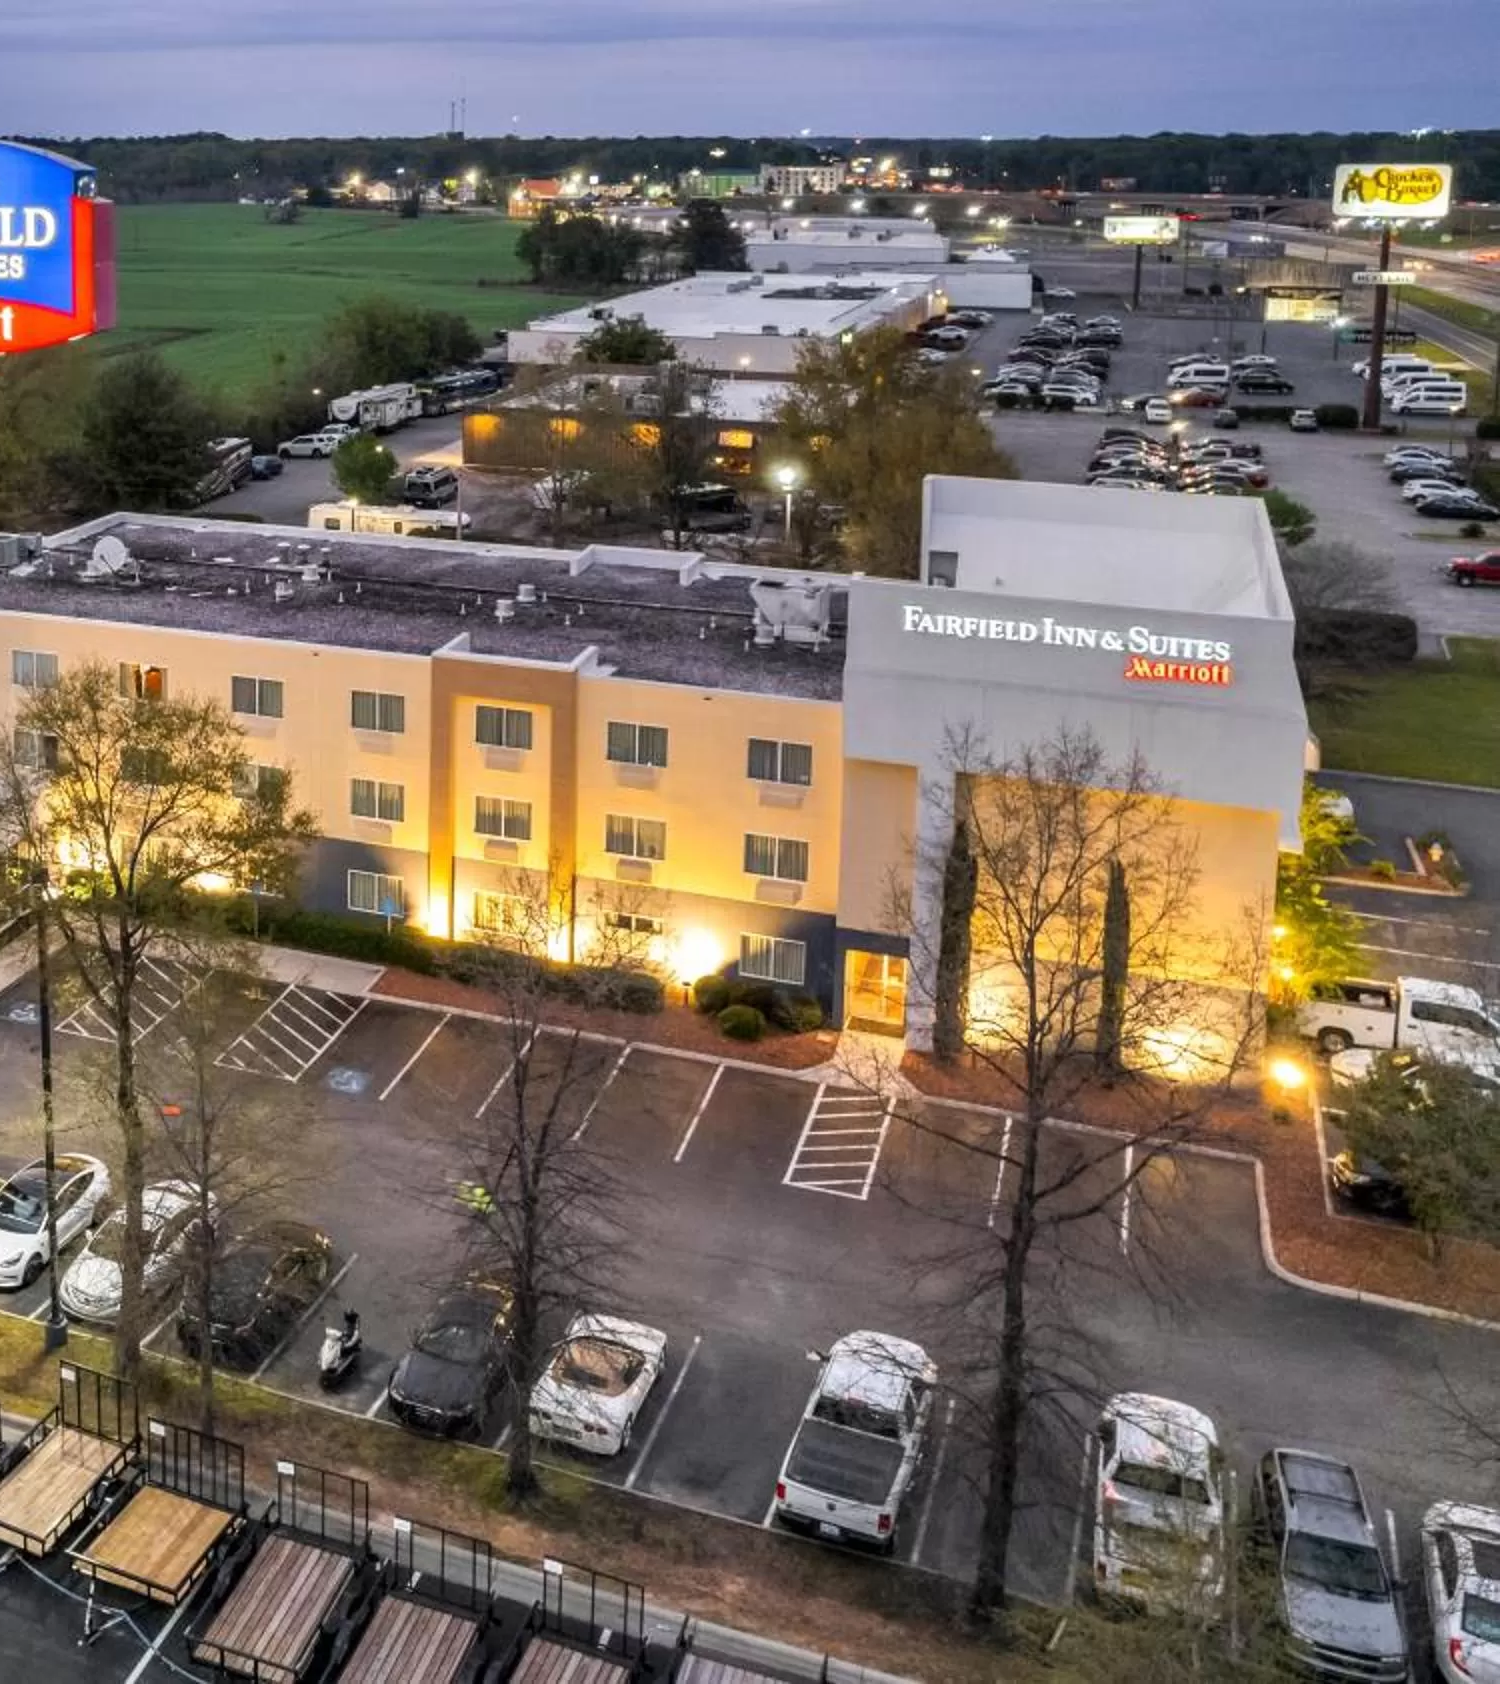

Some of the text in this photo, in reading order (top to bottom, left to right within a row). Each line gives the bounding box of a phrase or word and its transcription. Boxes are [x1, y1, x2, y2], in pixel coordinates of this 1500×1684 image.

[903, 605, 1231, 662] FAIRFIELD INN & SUITES
[1124, 656, 1230, 685] Marriott
